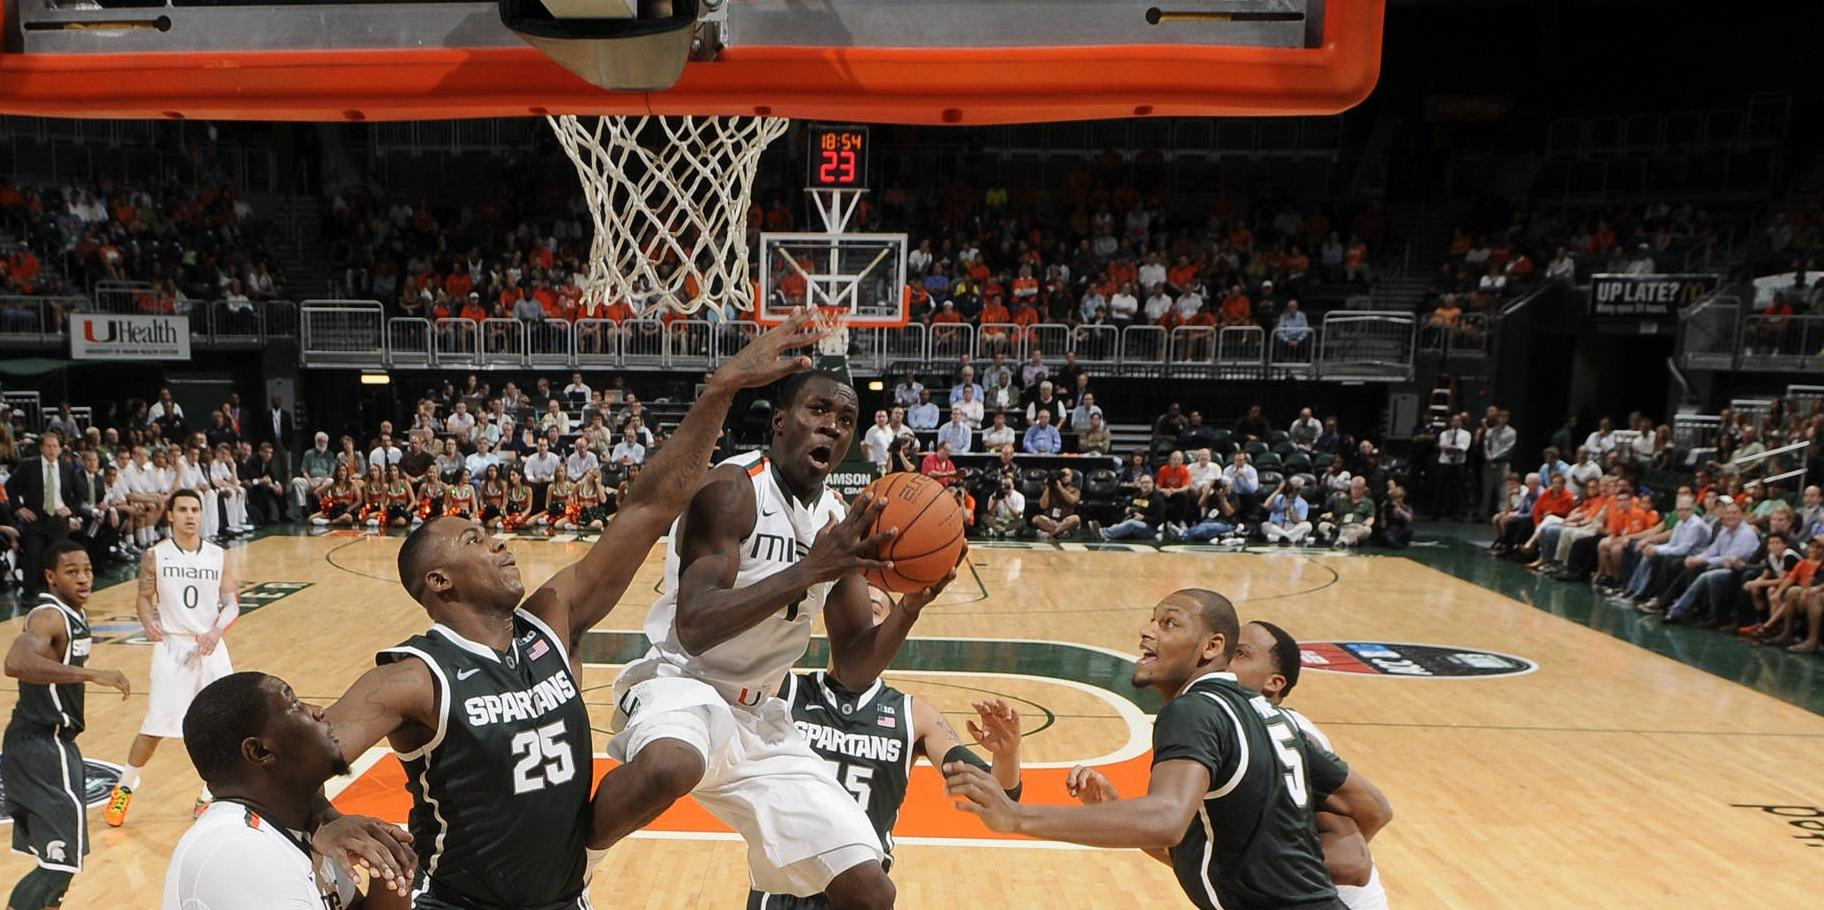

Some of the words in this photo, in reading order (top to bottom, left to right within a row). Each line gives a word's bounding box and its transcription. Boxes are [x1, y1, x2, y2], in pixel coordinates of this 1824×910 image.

[821, 133, 862, 150] 18:54
[819, 151, 855, 183] 23
[1597, 282, 1622, 301] UP
[1624, 282, 1680, 301] LATE?
[183, 585, 199, 609] 0
[511, 718, 576, 795] 25
[793, 720, 902, 763] SPARTANS
[1267, 722, 1308, 808] 5
